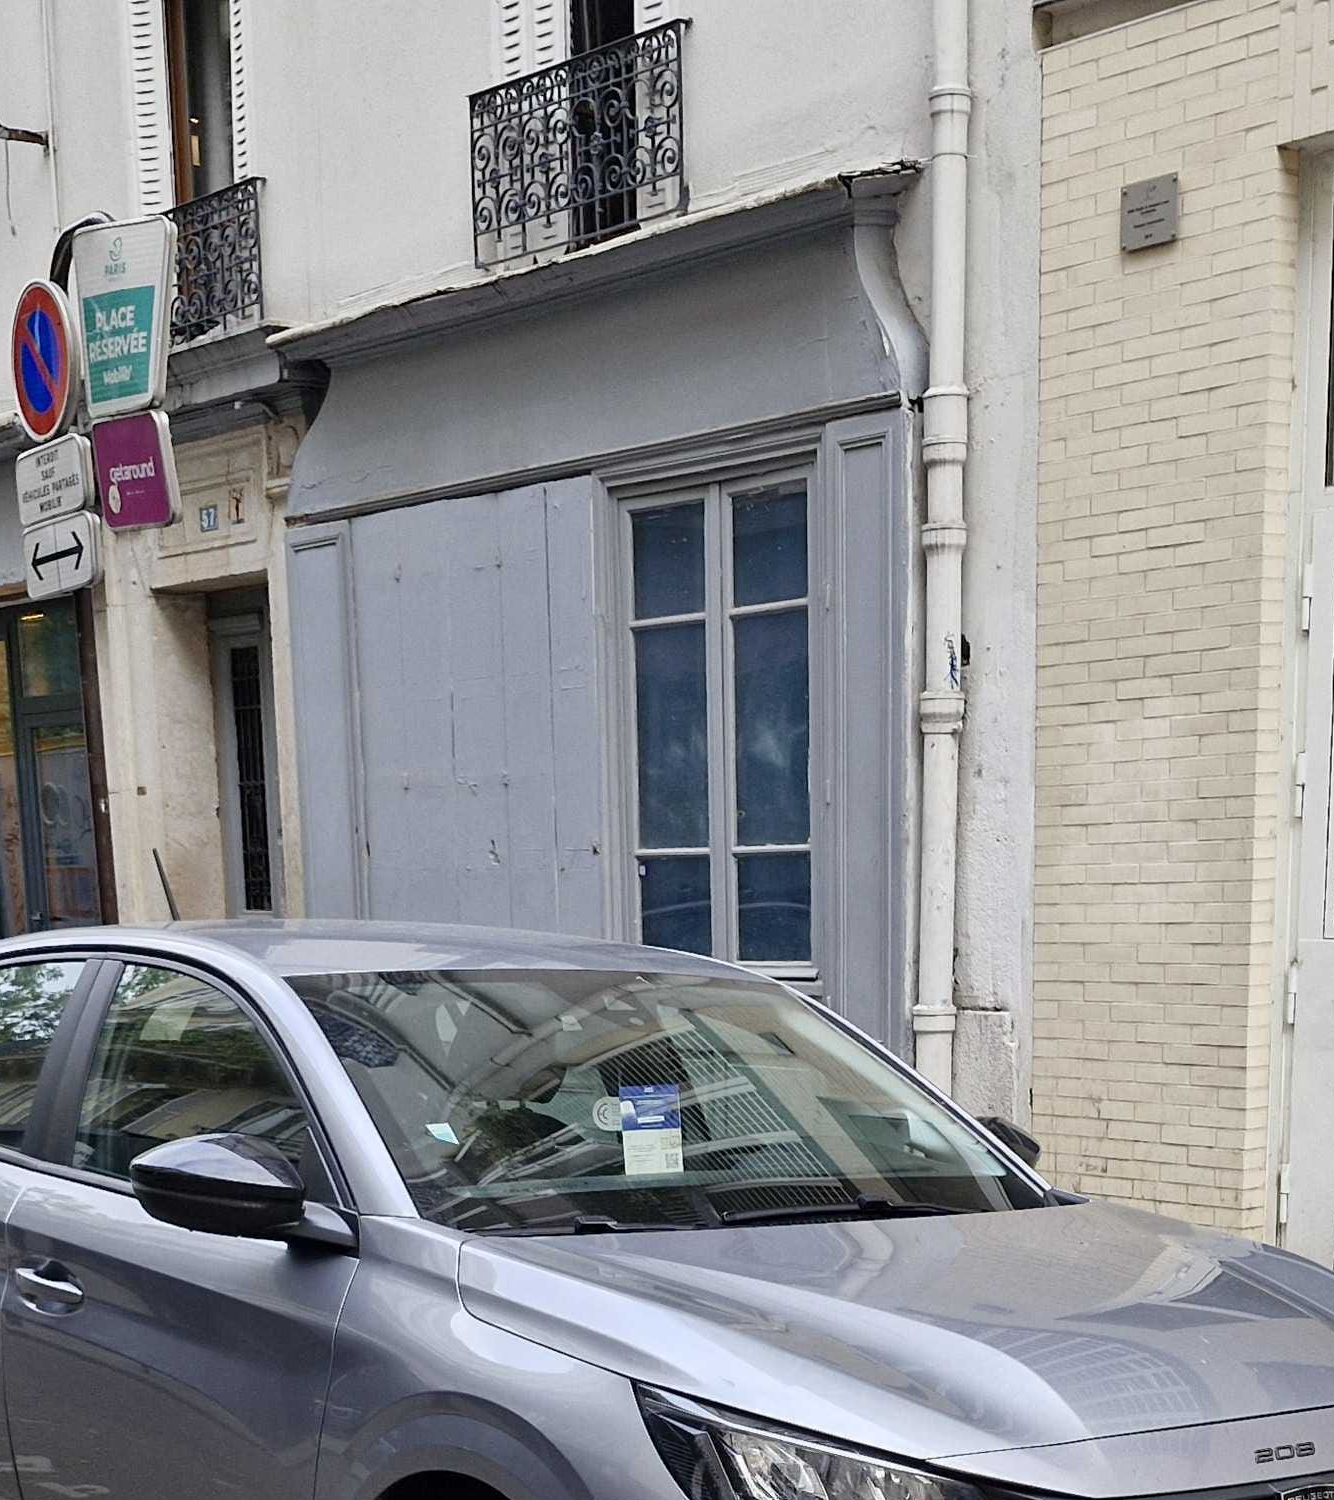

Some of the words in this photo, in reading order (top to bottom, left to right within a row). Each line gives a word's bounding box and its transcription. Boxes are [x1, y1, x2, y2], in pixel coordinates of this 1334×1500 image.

[104, 262, 127, 276] PARIS
[95, 304, 136, 332] PLACE
[88, 327, 148, 363] RÉSERVÉE
[109, 456, 156, 486] getaround
[201, 508, 215, 528] 57
[1254, 1441, 1316, 1465] 208
